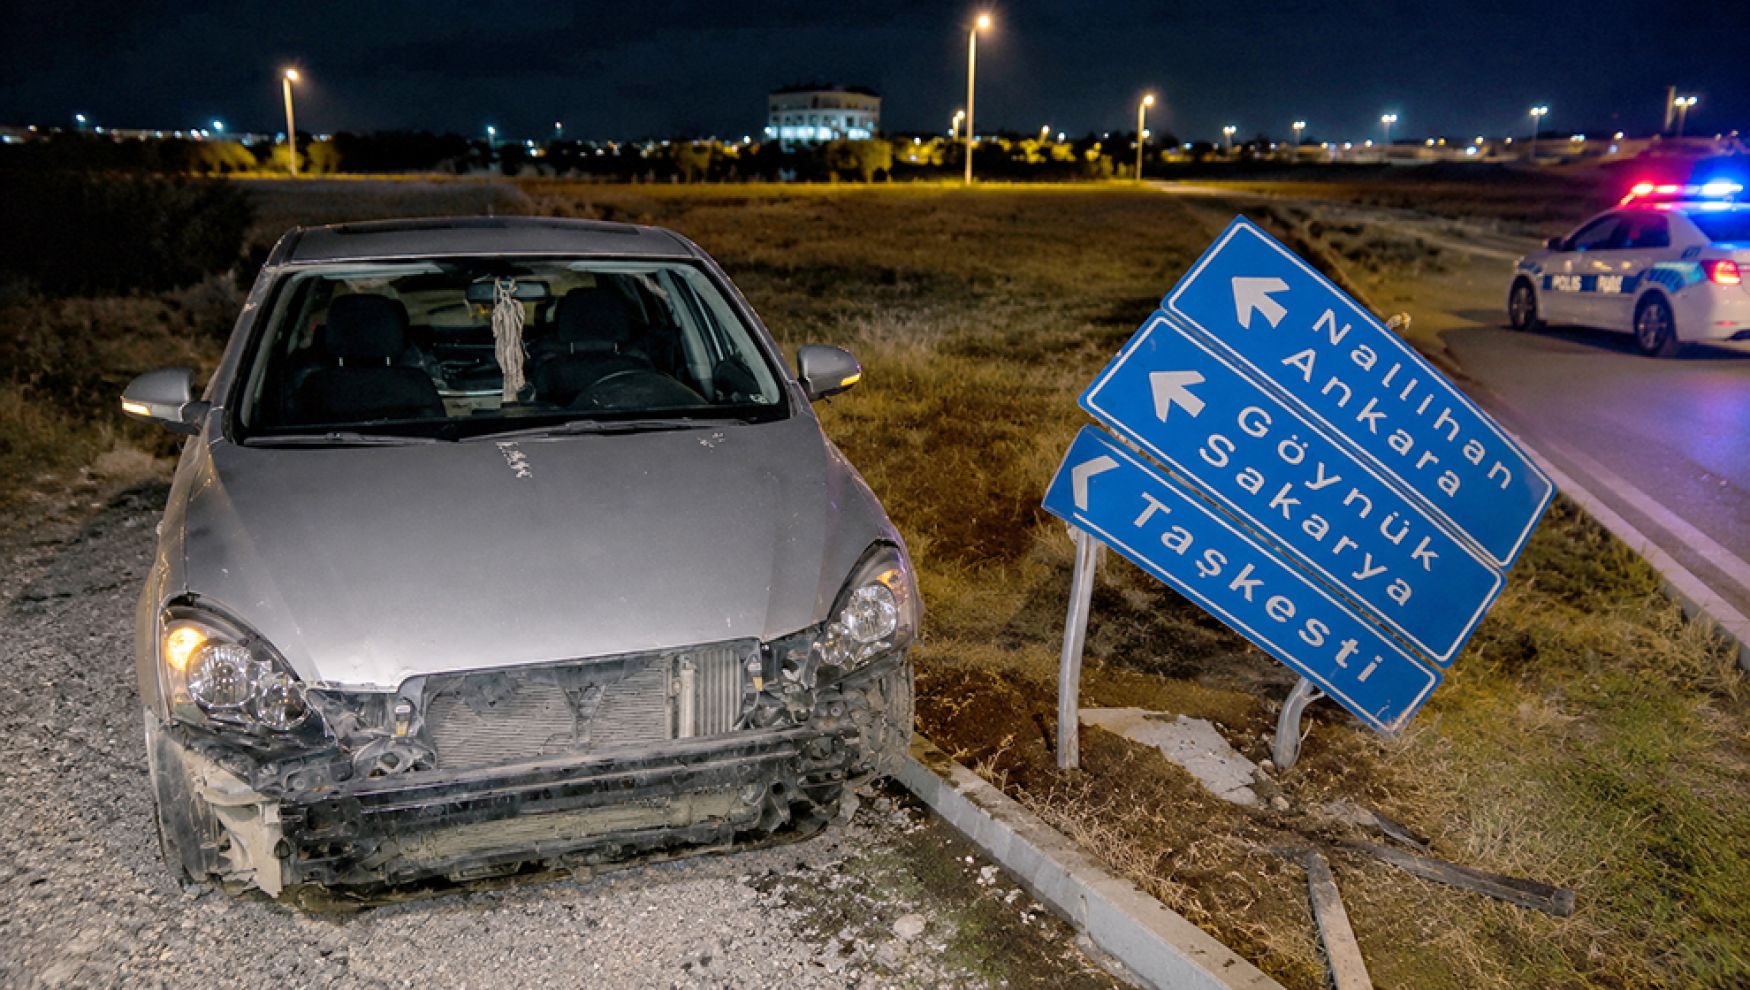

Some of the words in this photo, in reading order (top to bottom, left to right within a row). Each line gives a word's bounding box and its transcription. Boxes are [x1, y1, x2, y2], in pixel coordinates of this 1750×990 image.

[1237, 405, 1439, 571] Göynük
[1281, 347, 1461, 498] Ankara
[1133, 491, 1383, 682] Taşkesti
[1199, 433, 1413, 606] Sakarya
